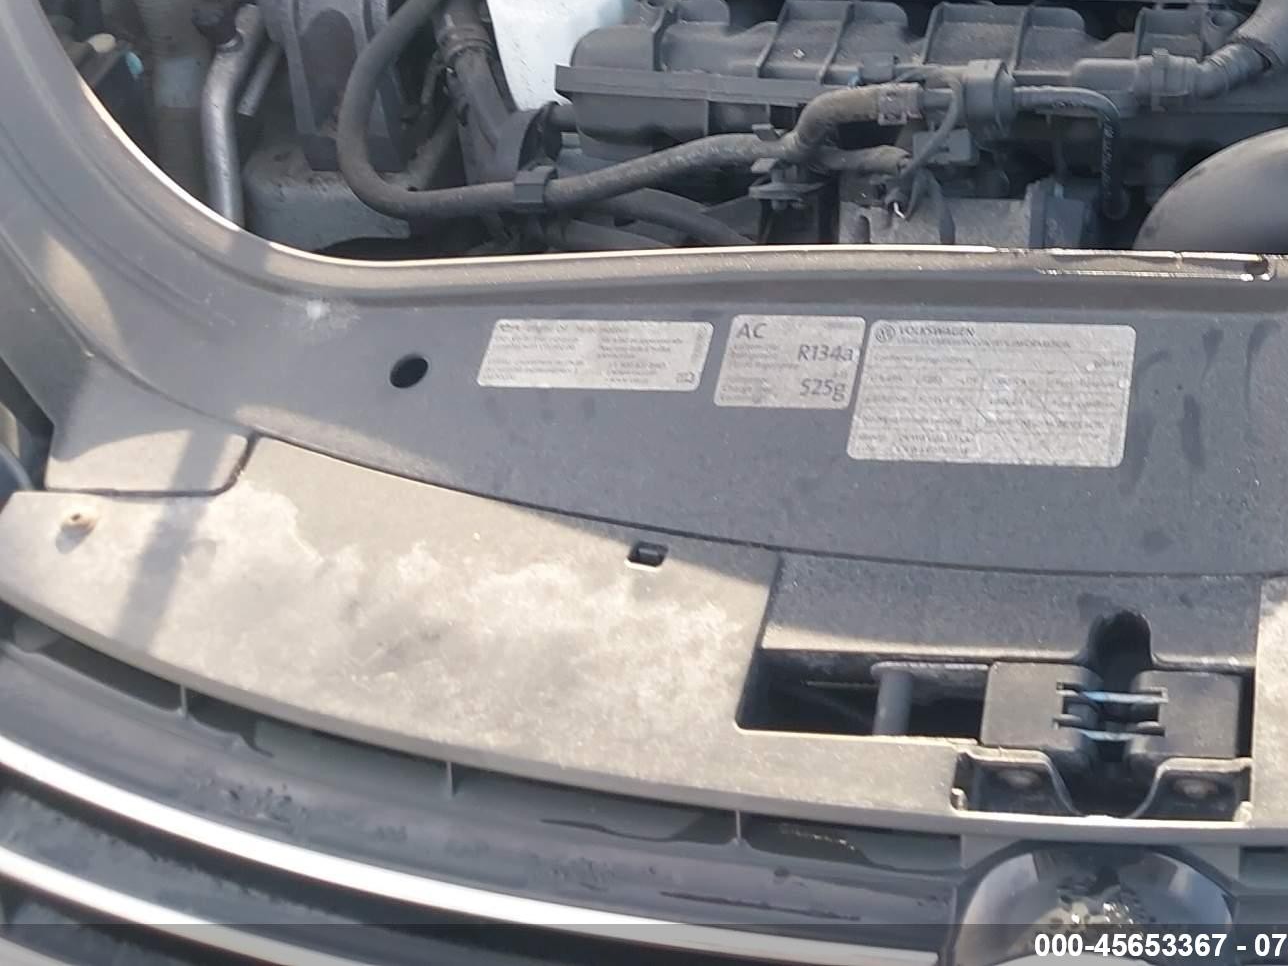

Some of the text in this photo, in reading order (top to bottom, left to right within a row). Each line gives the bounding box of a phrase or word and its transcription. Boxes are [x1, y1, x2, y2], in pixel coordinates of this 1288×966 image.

[735, 322, 768, 339] AC
[798, 343, 855, 362] R134a
[799, 377, 847, 403] 525g
